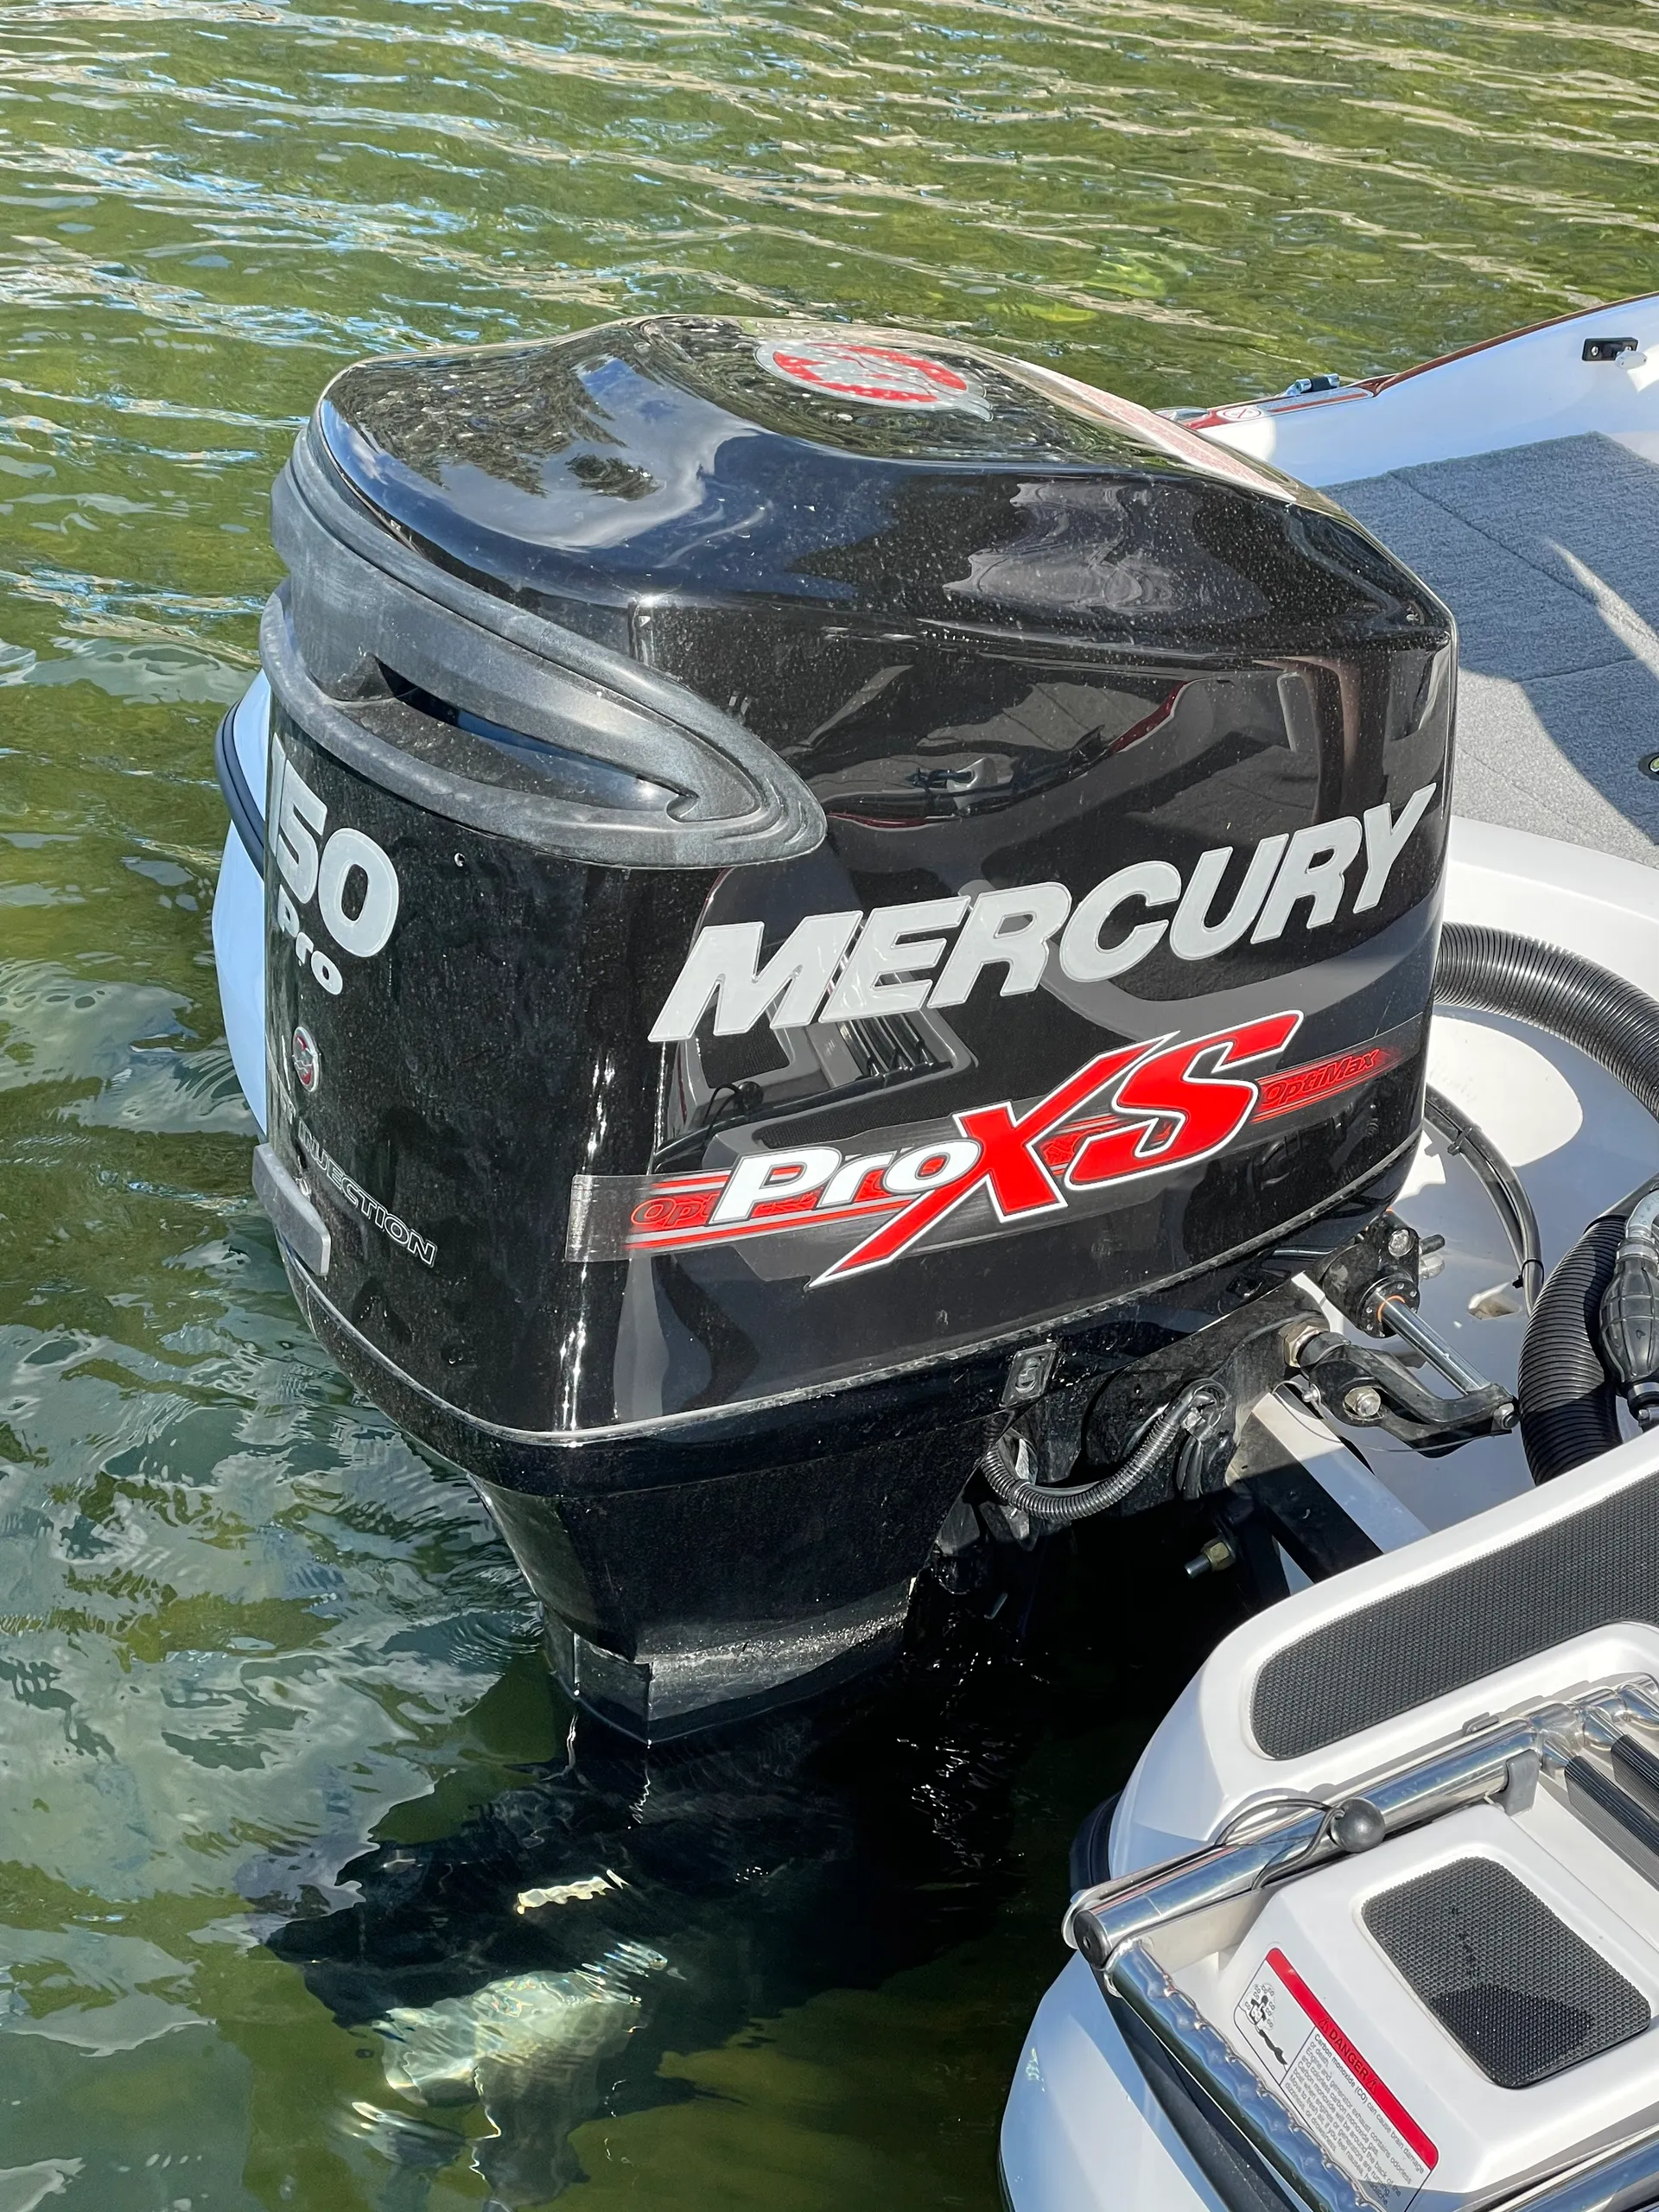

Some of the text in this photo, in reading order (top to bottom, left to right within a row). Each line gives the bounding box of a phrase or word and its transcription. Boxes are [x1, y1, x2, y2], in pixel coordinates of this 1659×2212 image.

[277, 884, 343, 995] Pro
[648, 783, 1435, 1042] MERCURY
[1262, 1047, 1380, 1107] OptiMax
[298, 1116, 438, 1268] INJECTION
[1309, 2040, 1316, 2050] or
[1328, 2027, 1370, 2081] DANGER
[1287, 2074, 1303, 2093] Move
[1300, 2090, 1307, 2100] to
[1305, 2096, 1319, 2115] fresh
[1326, 2126, 1338, 2142] you
[1336, 2137, 1348, 2152] feel
[1292, 2067, 1305, 2083] boat
[1302, 2081, 1317, 2100] when
[1313, 2097, 1334, 2124] engines
[1332, 2120, 1339, 2130] or
[1337, 2128, 1363, 2163] generators
[1362, 2159, 1372, 2172] are
[1296, 2059, 1402, 2197] Carbon monoxide will be around the back of the
[1300, 2054, 1380, 2158] and colorless carbon monoxide gas.
[1304, 2046, 1413, 2185] Engine and generator exhaust contains odorless
[1305, 2109, 1312, 2119] or
[1313, 2031, 1425, 2176] Carbon monoxide (CO) can cause brain damage
